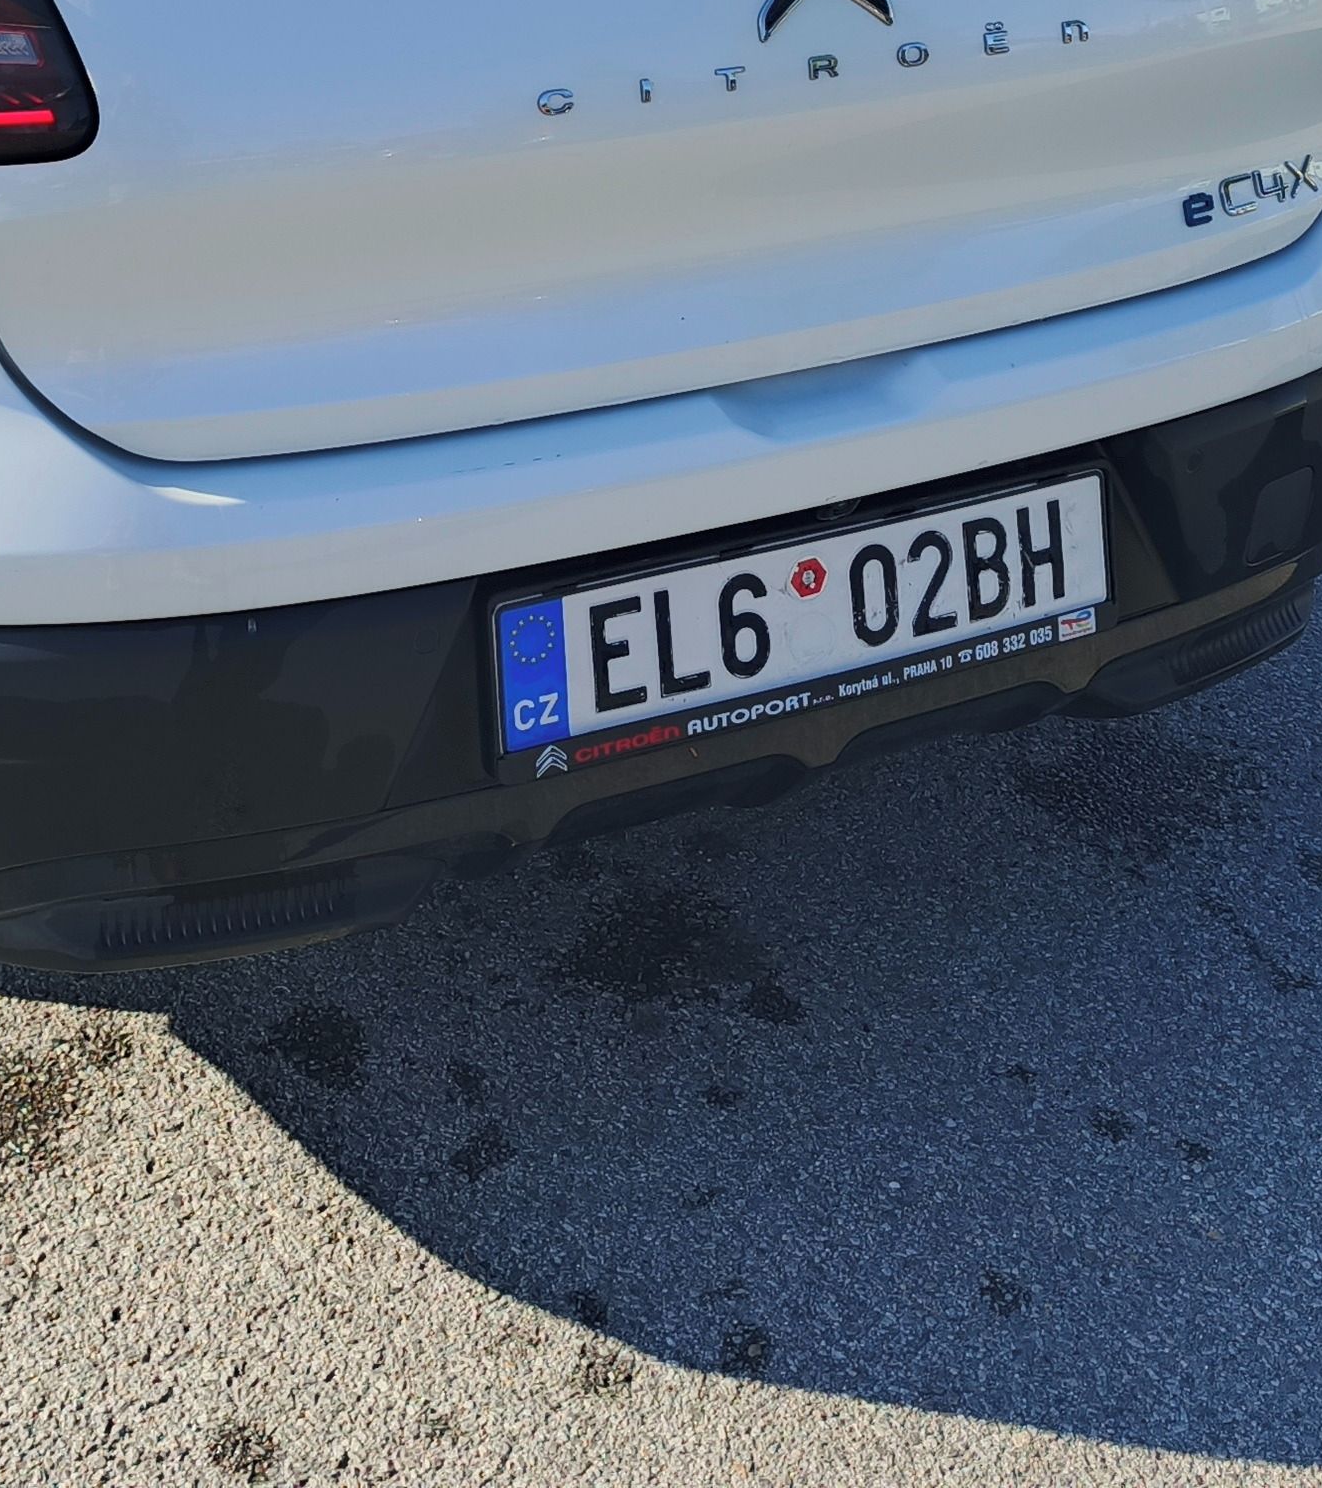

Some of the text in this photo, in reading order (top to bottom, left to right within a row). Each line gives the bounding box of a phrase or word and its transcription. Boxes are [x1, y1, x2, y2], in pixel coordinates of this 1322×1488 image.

[589, 499, 1065, 712] EL6 02BH
[513, 692, 559, 732] CZ
[687, 690, 811, 736] AUTOPORT
[838, 674, 879, 698] Korytná
[903, 659, 937, 681] PRAHA
[940, 655, 953, 670] 10
[975, 640, 999, 661] 608
[1002, 632, 1027, 653] 332
[1029, 625, 1054, 646] 035
